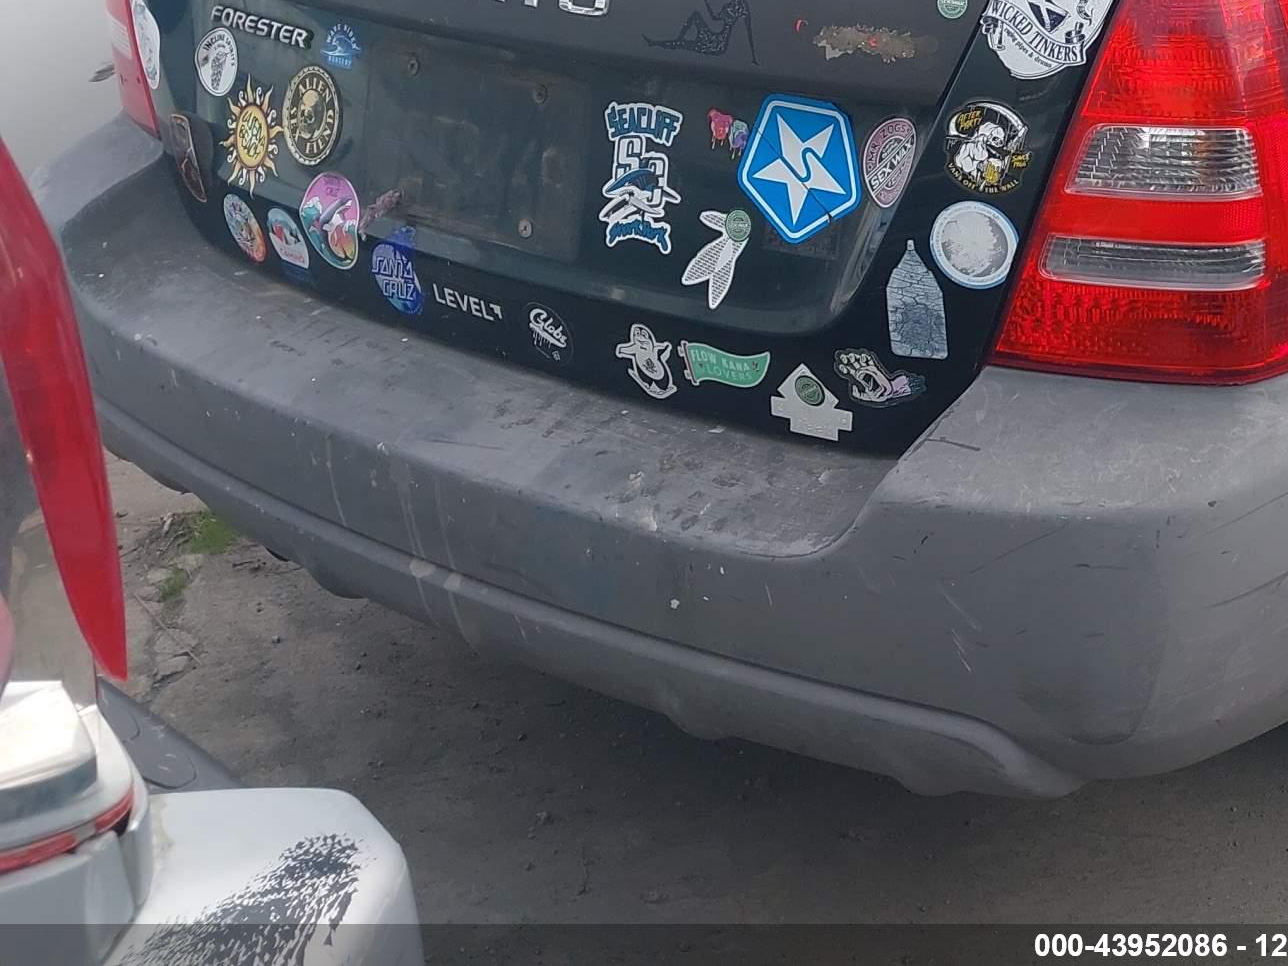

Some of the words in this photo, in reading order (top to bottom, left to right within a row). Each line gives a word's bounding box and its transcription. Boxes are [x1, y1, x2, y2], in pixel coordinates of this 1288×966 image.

[210, 4, 309, 50] FORESTER
[991, 0, 1034, 35] WICKED
[1029, 30, 1078, 63] TINKERS
[299, 77, 333, 104] ALIEN
[603, 104, 681, 145] SEACLIFF
[870, 161, 893, 190] SEX
[891, 136, 913, 167] WAX
[948, 163, 962, 182] VANS
[1001, 179, 1020, 192] WALL
[371, 256, 414, 279] SANTA
[382, 278, 416, 301] CRUZ
[690, 349, 718, 365] FLOW
[721, 358, 750, 372] KANA
